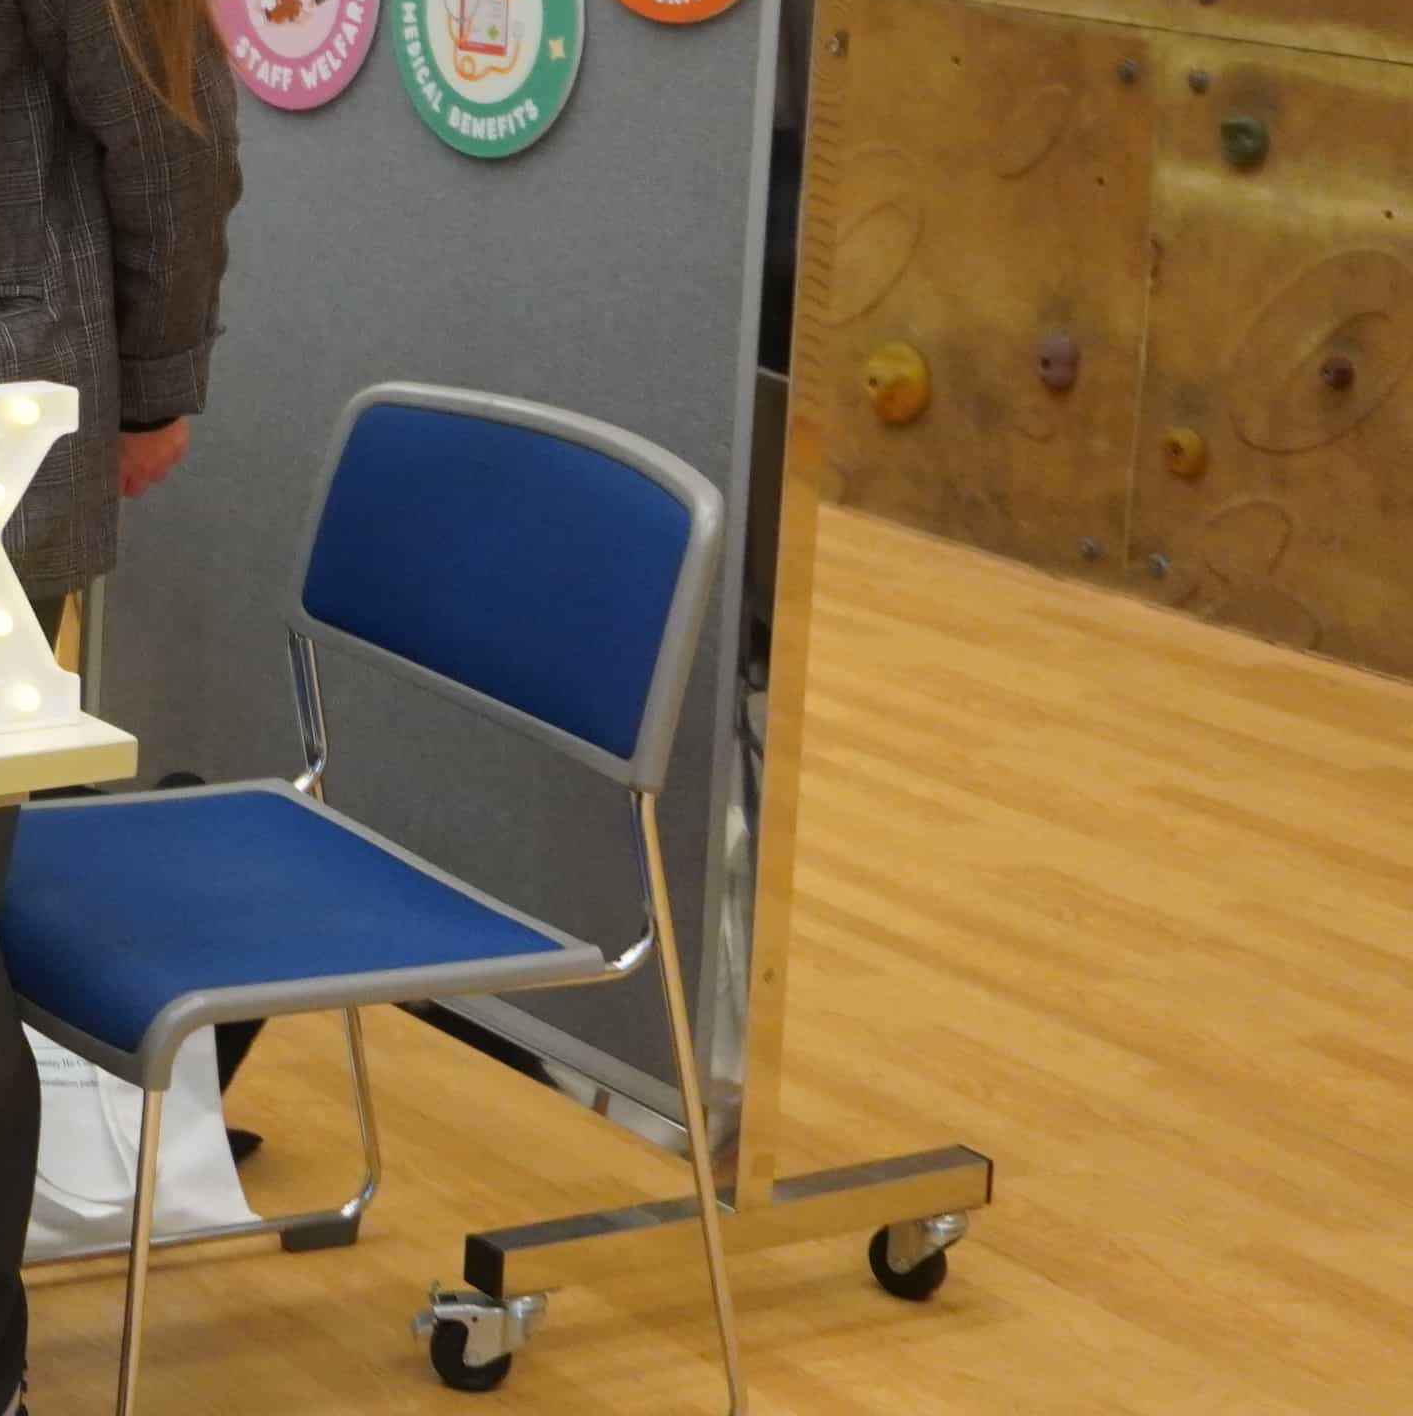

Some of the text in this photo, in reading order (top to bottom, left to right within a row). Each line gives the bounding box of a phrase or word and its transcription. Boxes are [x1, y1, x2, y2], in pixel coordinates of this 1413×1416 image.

[234, 37, 293, 91] STAFF
[401, 1, 540, 141] MEDICAL BENEFITS
